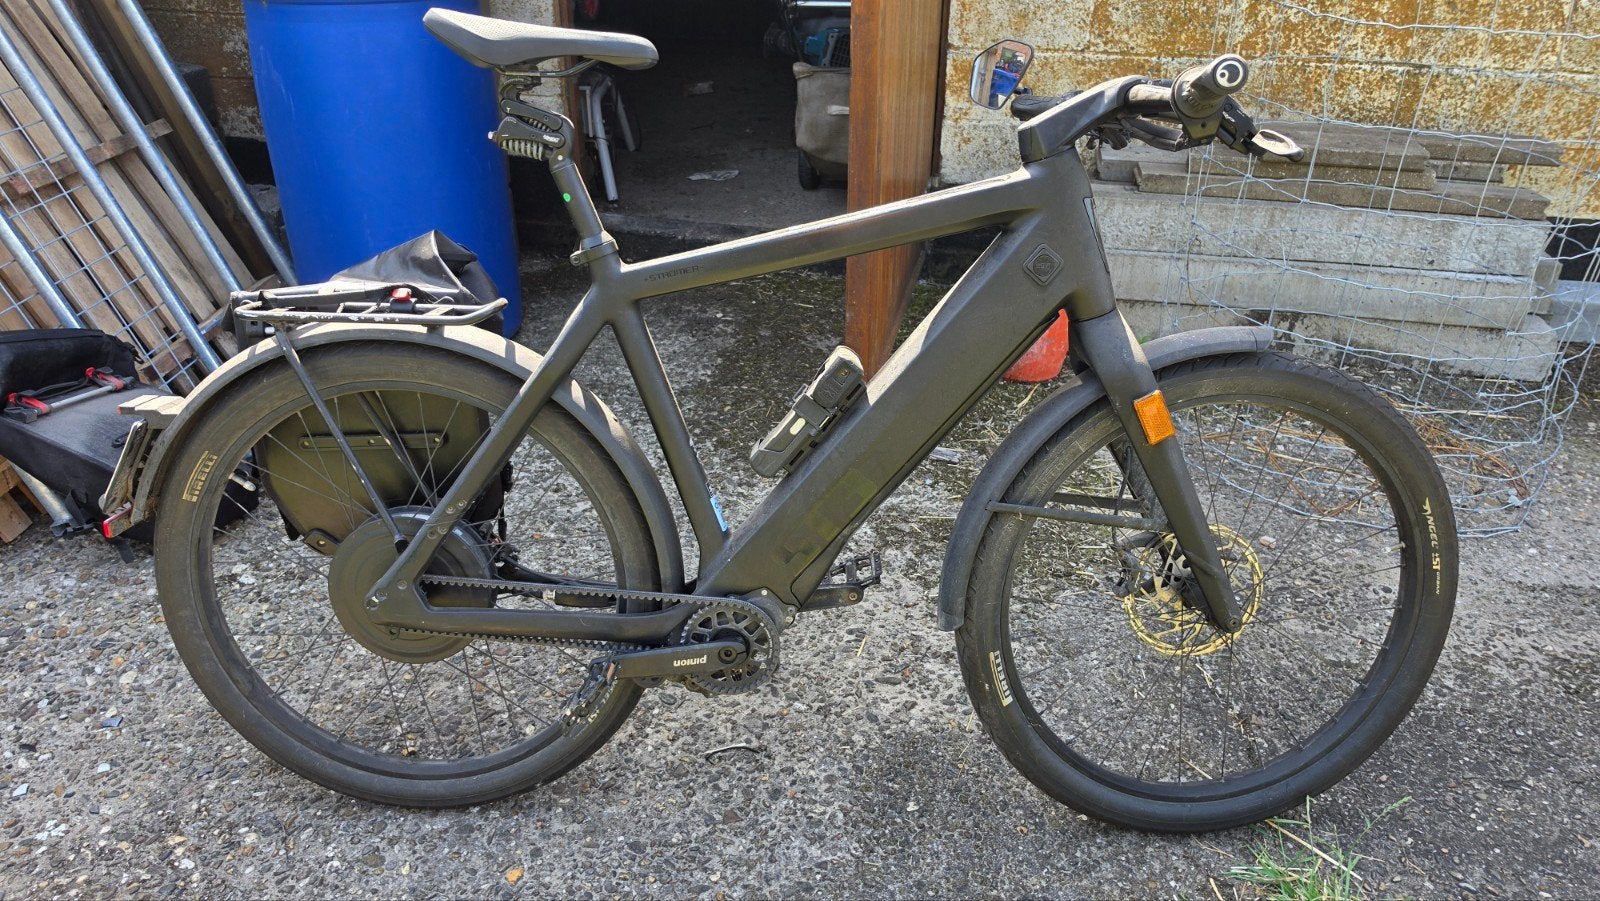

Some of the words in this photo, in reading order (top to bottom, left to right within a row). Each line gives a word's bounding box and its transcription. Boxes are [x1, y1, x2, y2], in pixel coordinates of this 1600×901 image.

[182, 450, 218, 502] PIRELLI
[673, 654, 708, 667] pinion
[989, 649, 1014, 707] PIRELLI
